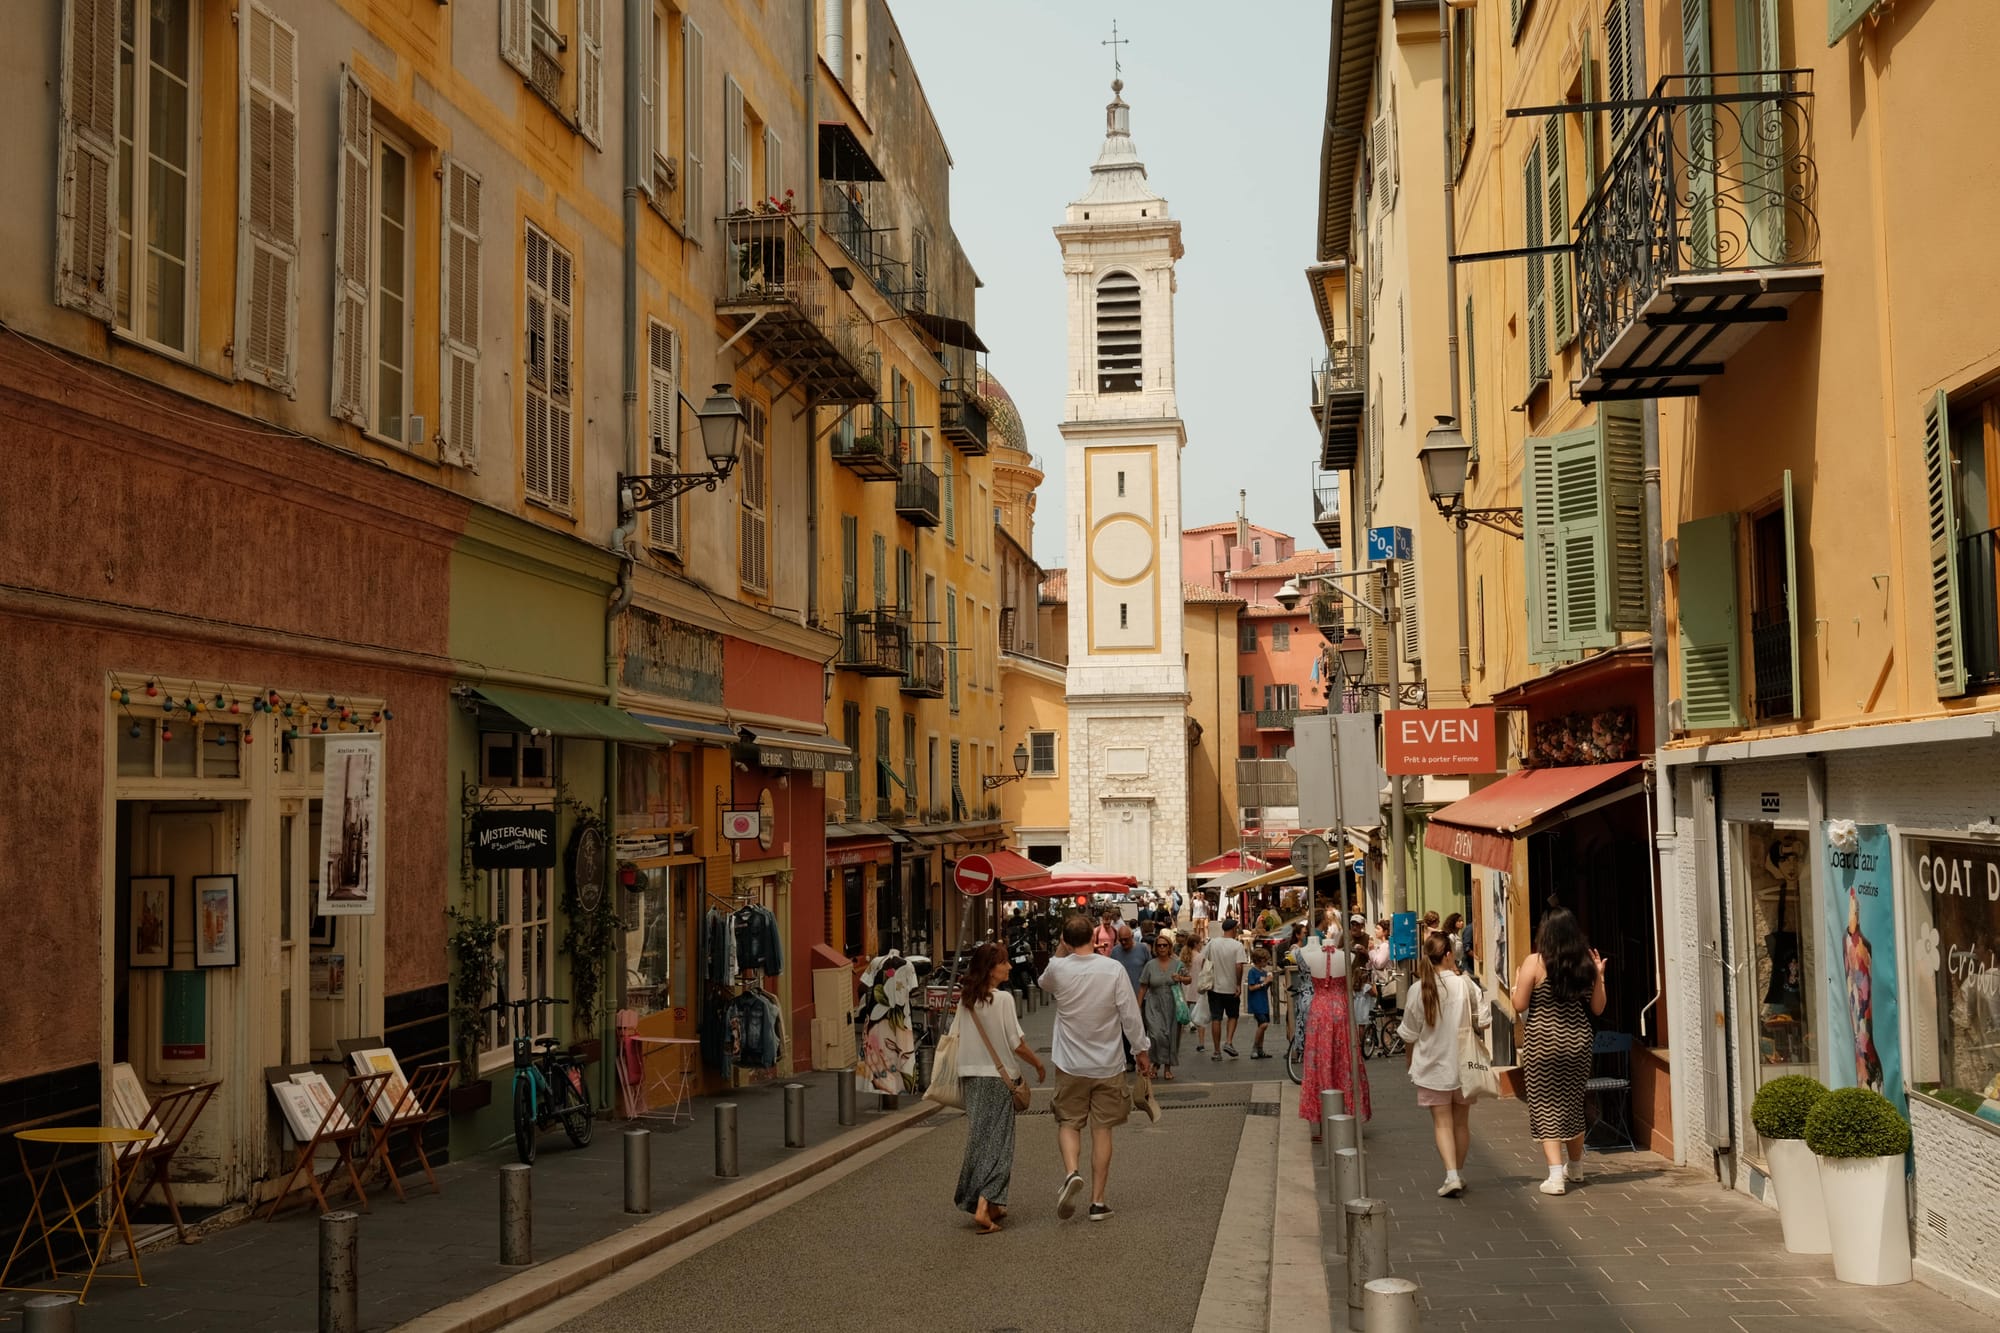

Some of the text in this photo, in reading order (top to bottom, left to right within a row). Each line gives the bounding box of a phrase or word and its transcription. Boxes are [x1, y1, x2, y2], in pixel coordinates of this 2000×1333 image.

[1370, 529, 1393, 559] SOS
[1396, 528, 1411, 560] SOS
[1401, 719, 1479, 744] EVEN
[1403, 755, 1479, 764] Prêt à porter Femme
[480, 826, 548, 847] MISTERGANNE
[1454, 832, 1473, 857] EVEN
[1918, 854, 1972, 898] COAT
